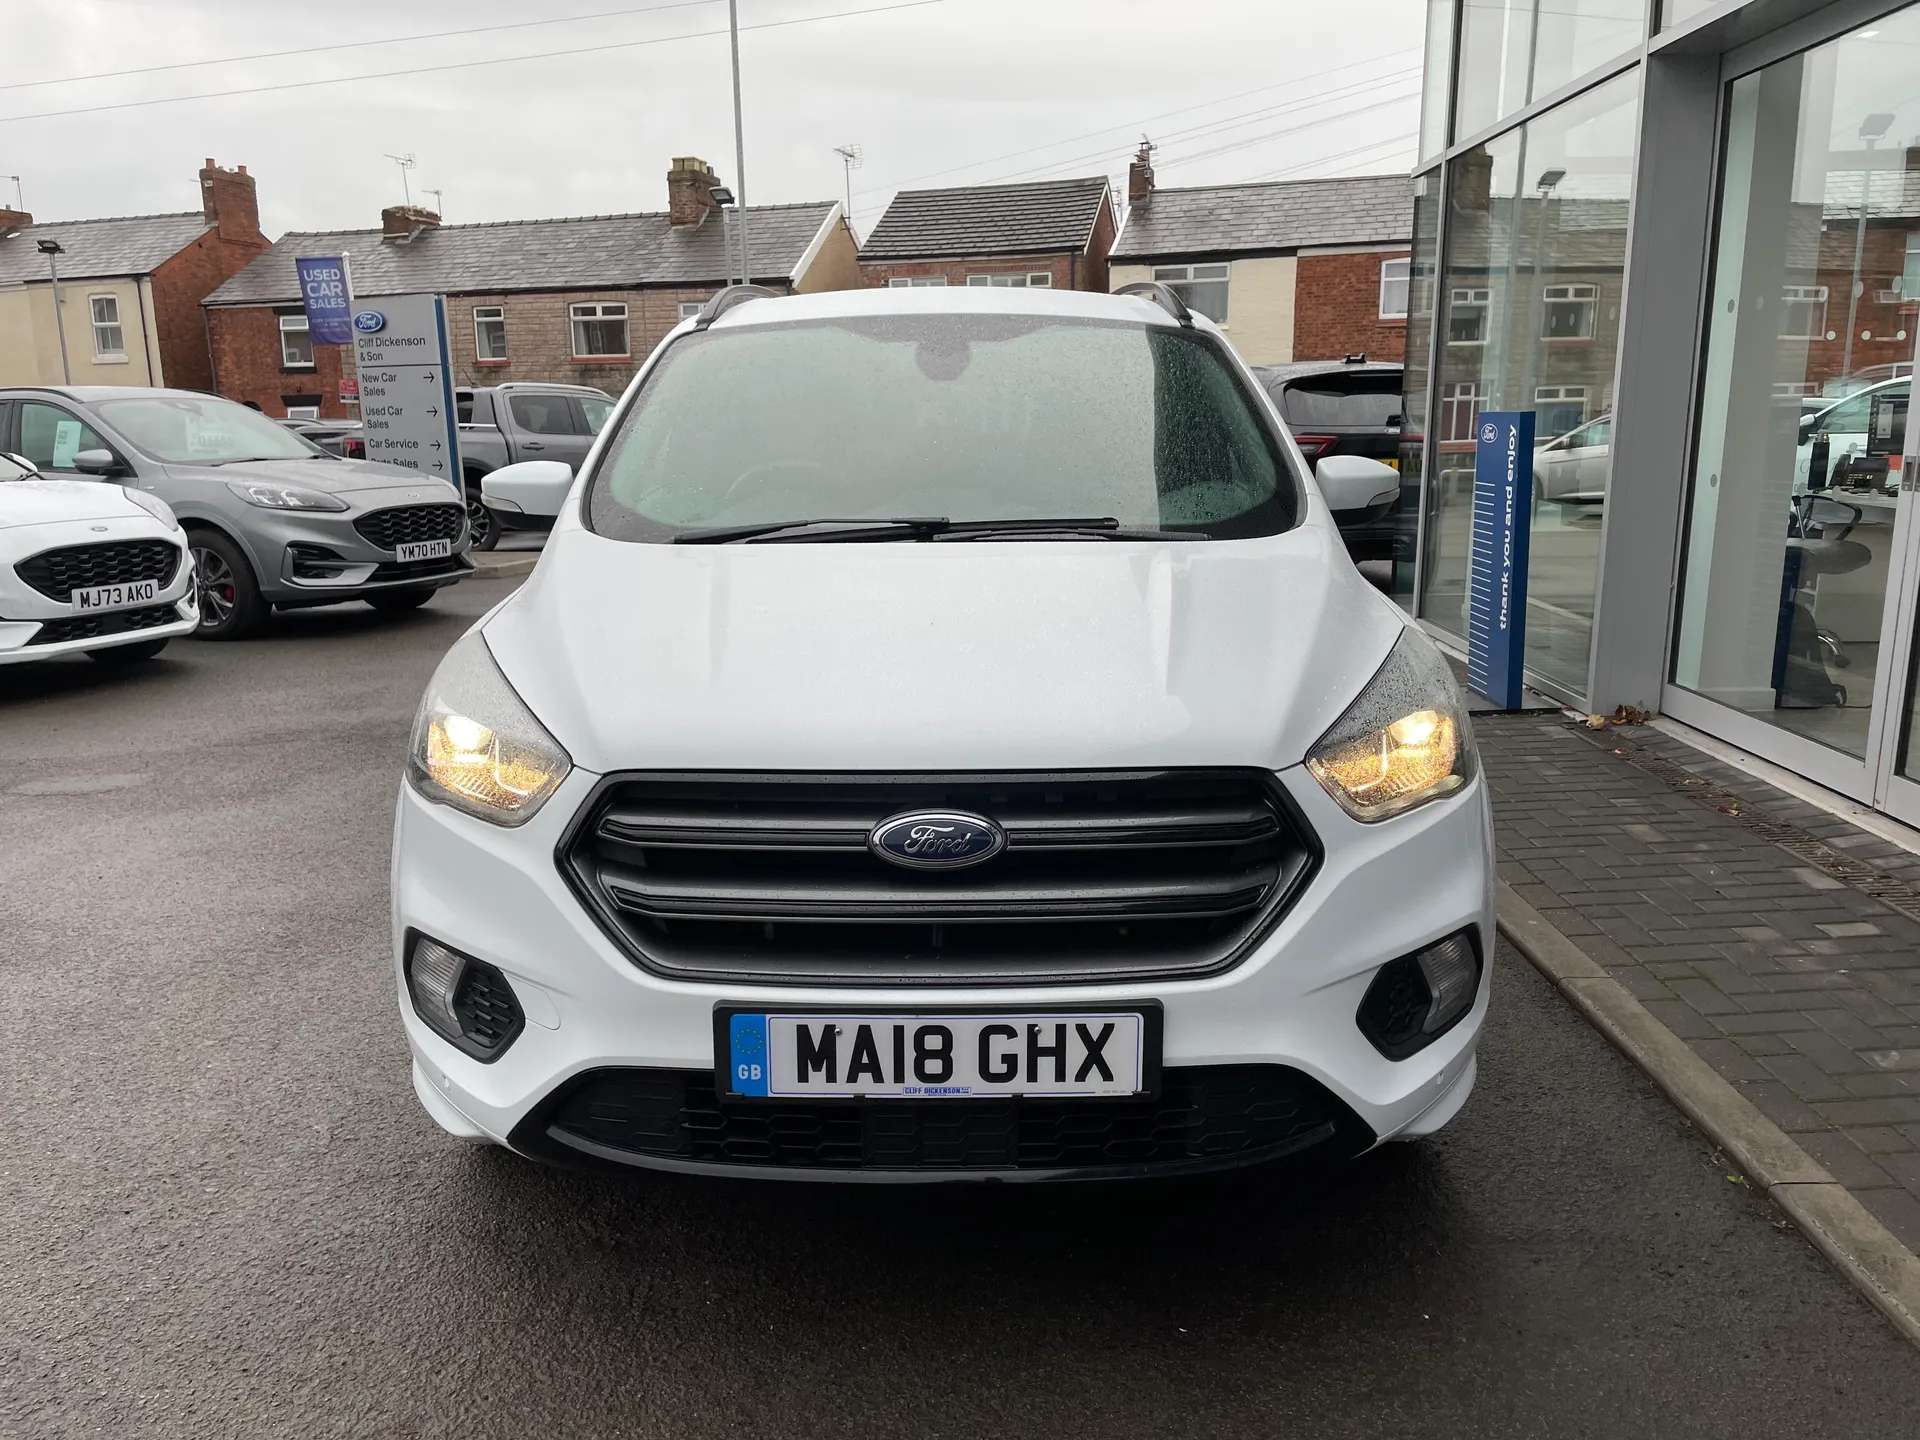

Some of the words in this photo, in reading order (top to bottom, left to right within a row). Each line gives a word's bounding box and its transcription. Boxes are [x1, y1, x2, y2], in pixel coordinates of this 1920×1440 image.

[303, 268, 341, 281] USED
[307, 281, 344, 297] CAR
[310, 297, 347, 309] SALES
[358, 314, 377, 329] Ford
[358, 337, 374, 349] Cliff
[375, 335, 426, 347] Dickenson
[360, 351, 366, 361] &
[367, 350, 384, 361] Son
[362, 373, 380, 383] New
[381, 372, 398, 383] Car
[363, 386, 386, 397] Sales
[365, 406, 386, 416] Used
[387, 406, 403, 416] Car
[367, 419, 390, 429] Sales
[369, 438, 383, 449] Car
[384, 438, 419, 449] Service
[1506, 424, 1517, 482] enjoy
[1505, 485, 1513, 526] and
[401, 544, 428, 559] YM70
[430, 541, 448, 556] HTN
[1503, 530, 1512, 567] you
[80, 588, 122, 608] MJ73
[127, 583, 153, 602] AKO
[1500, 572, 1510, 630] thank
[903, 825, 972, 853] Ford
[796, 1024, 954, 1084] MA18
[978, 1023, 1116, 1083] GHX
[738, 1064, 761, 1080] GB
[904, 1087, 923, 1095] CLIFF
[924, 1087, 960, 1095] DICKENSON
